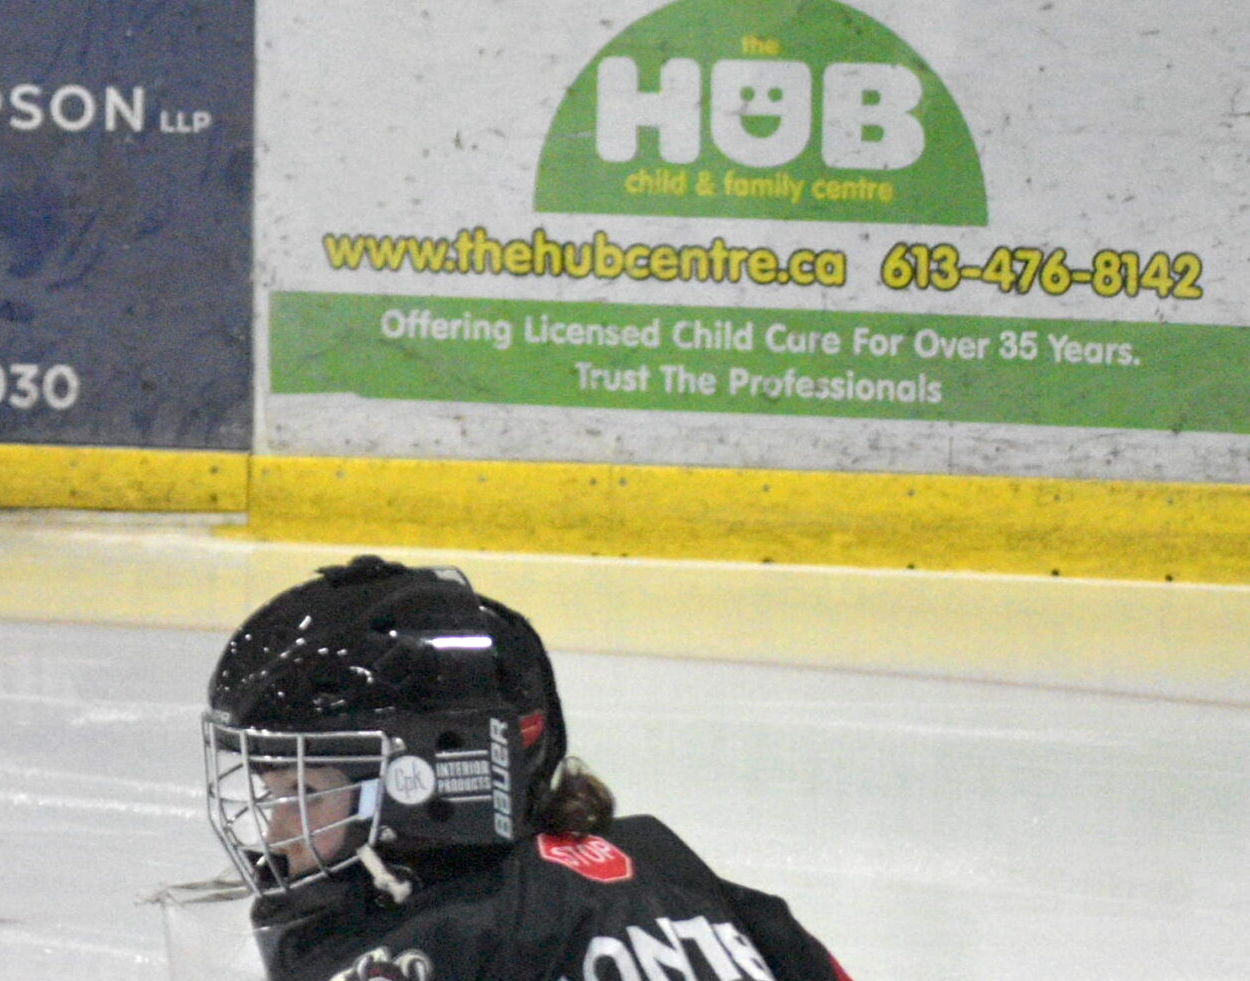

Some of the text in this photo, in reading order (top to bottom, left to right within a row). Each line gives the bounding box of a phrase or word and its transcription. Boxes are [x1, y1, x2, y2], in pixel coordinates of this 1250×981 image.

[741, 36, 782, 56] the
[160, 109, 213, 134] LLP
[596, 55, 926, 171] HUB
[625, 168, 895, 205] child & family centre
[321, 225, 1205, 300] www.thehubcentre.ca 613-476-8142
[381, 308, 1142, 367] Offering Licensed Child Care For Over 35 Years.
[575, 361, 943, 403] Trust The Professionals
[435, 759, 490, 779] INTERIOR
[437, 776, 492, 794] PRODUCTS
[550, 840, 616, 867] STOP
